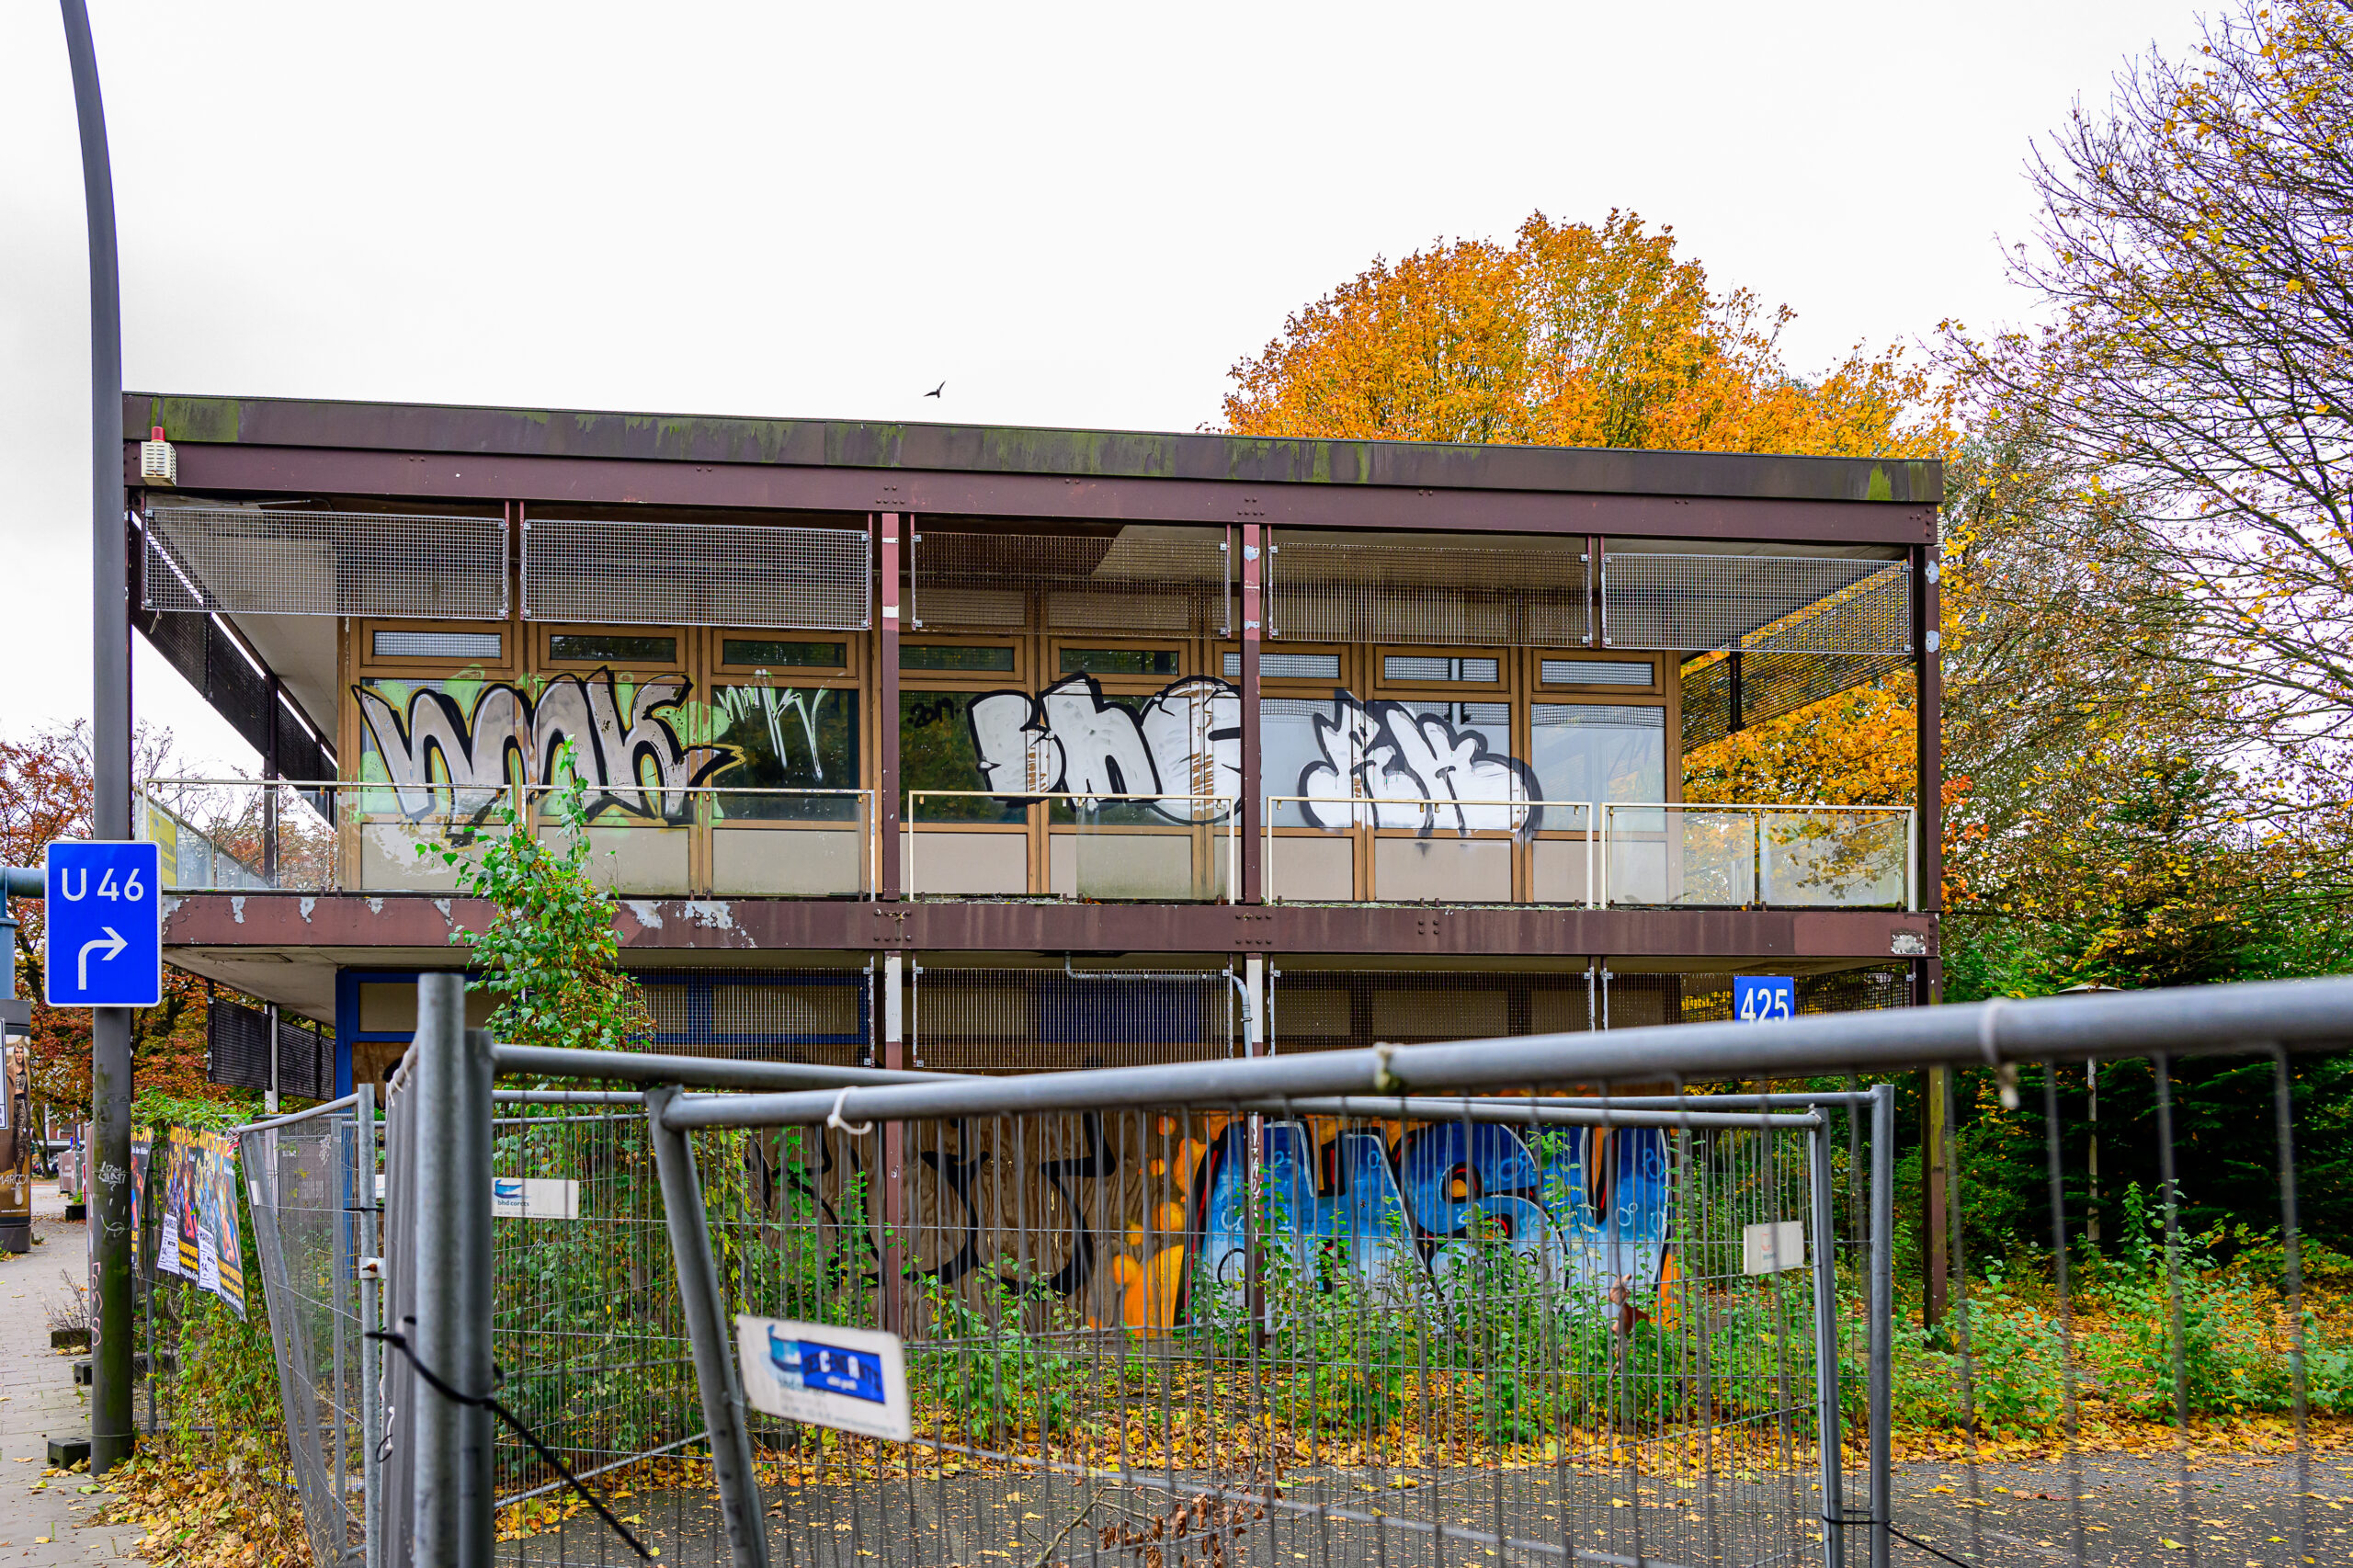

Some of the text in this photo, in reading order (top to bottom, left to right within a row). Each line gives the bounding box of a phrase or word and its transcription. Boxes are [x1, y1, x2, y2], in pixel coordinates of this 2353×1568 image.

[62, 868, 144, 902] U 46
[1740, 987, 1790, 1023] 425
